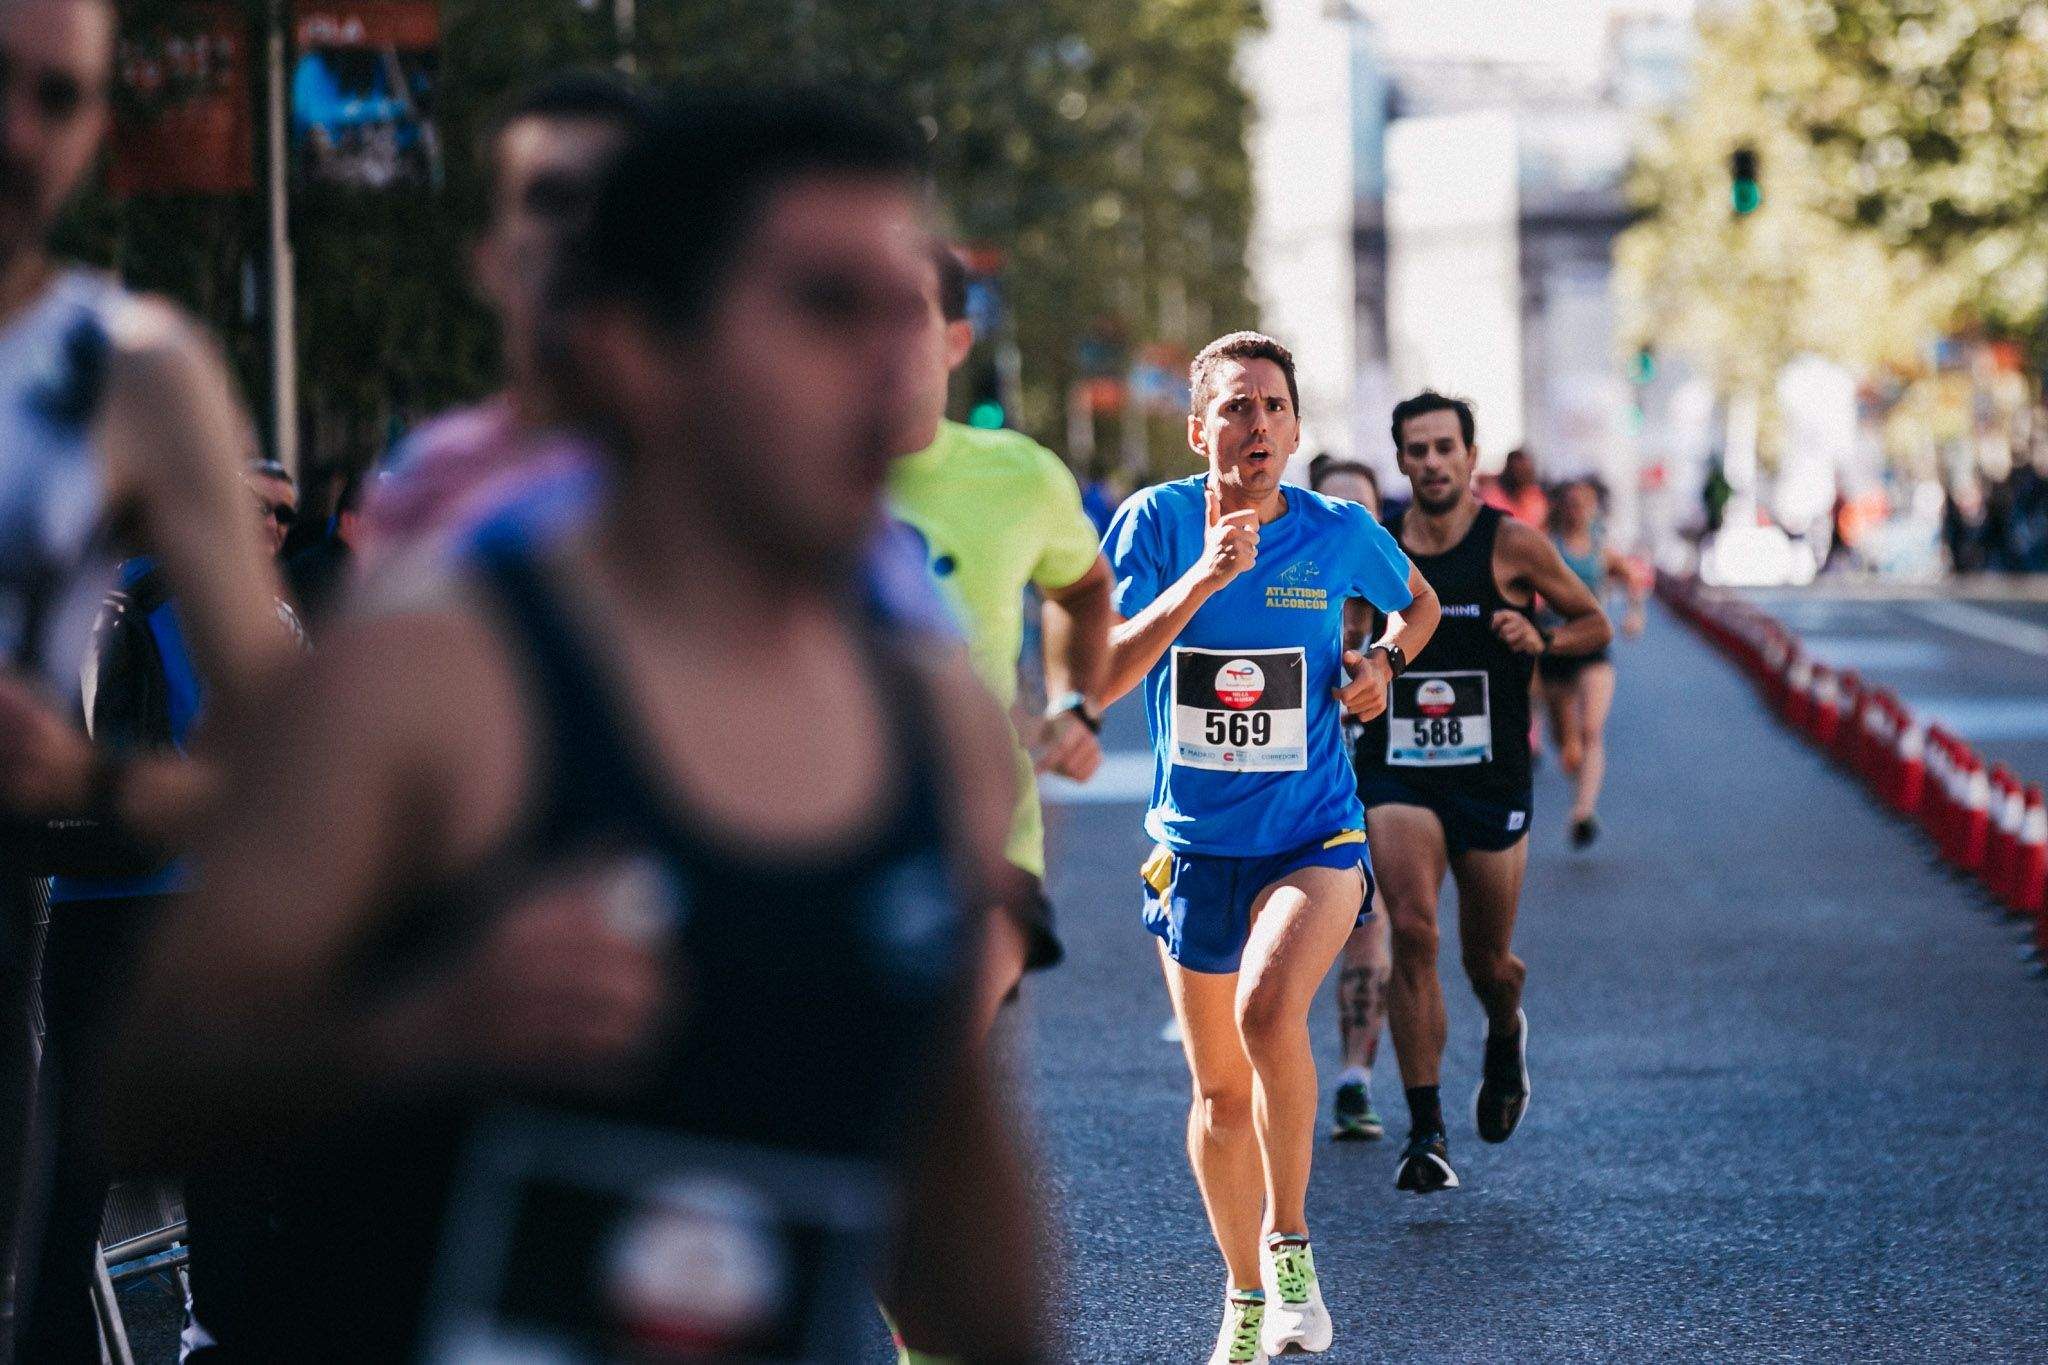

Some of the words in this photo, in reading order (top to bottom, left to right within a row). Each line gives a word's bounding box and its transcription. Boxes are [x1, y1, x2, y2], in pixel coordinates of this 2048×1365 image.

[1265, 586, 1327, 598] ATLETISMO
[1265, 597, 1328, 610] ALCORCÓN
[1205, 711, 1272, 747] 569
[1413, 718, 1464, 748] 588
